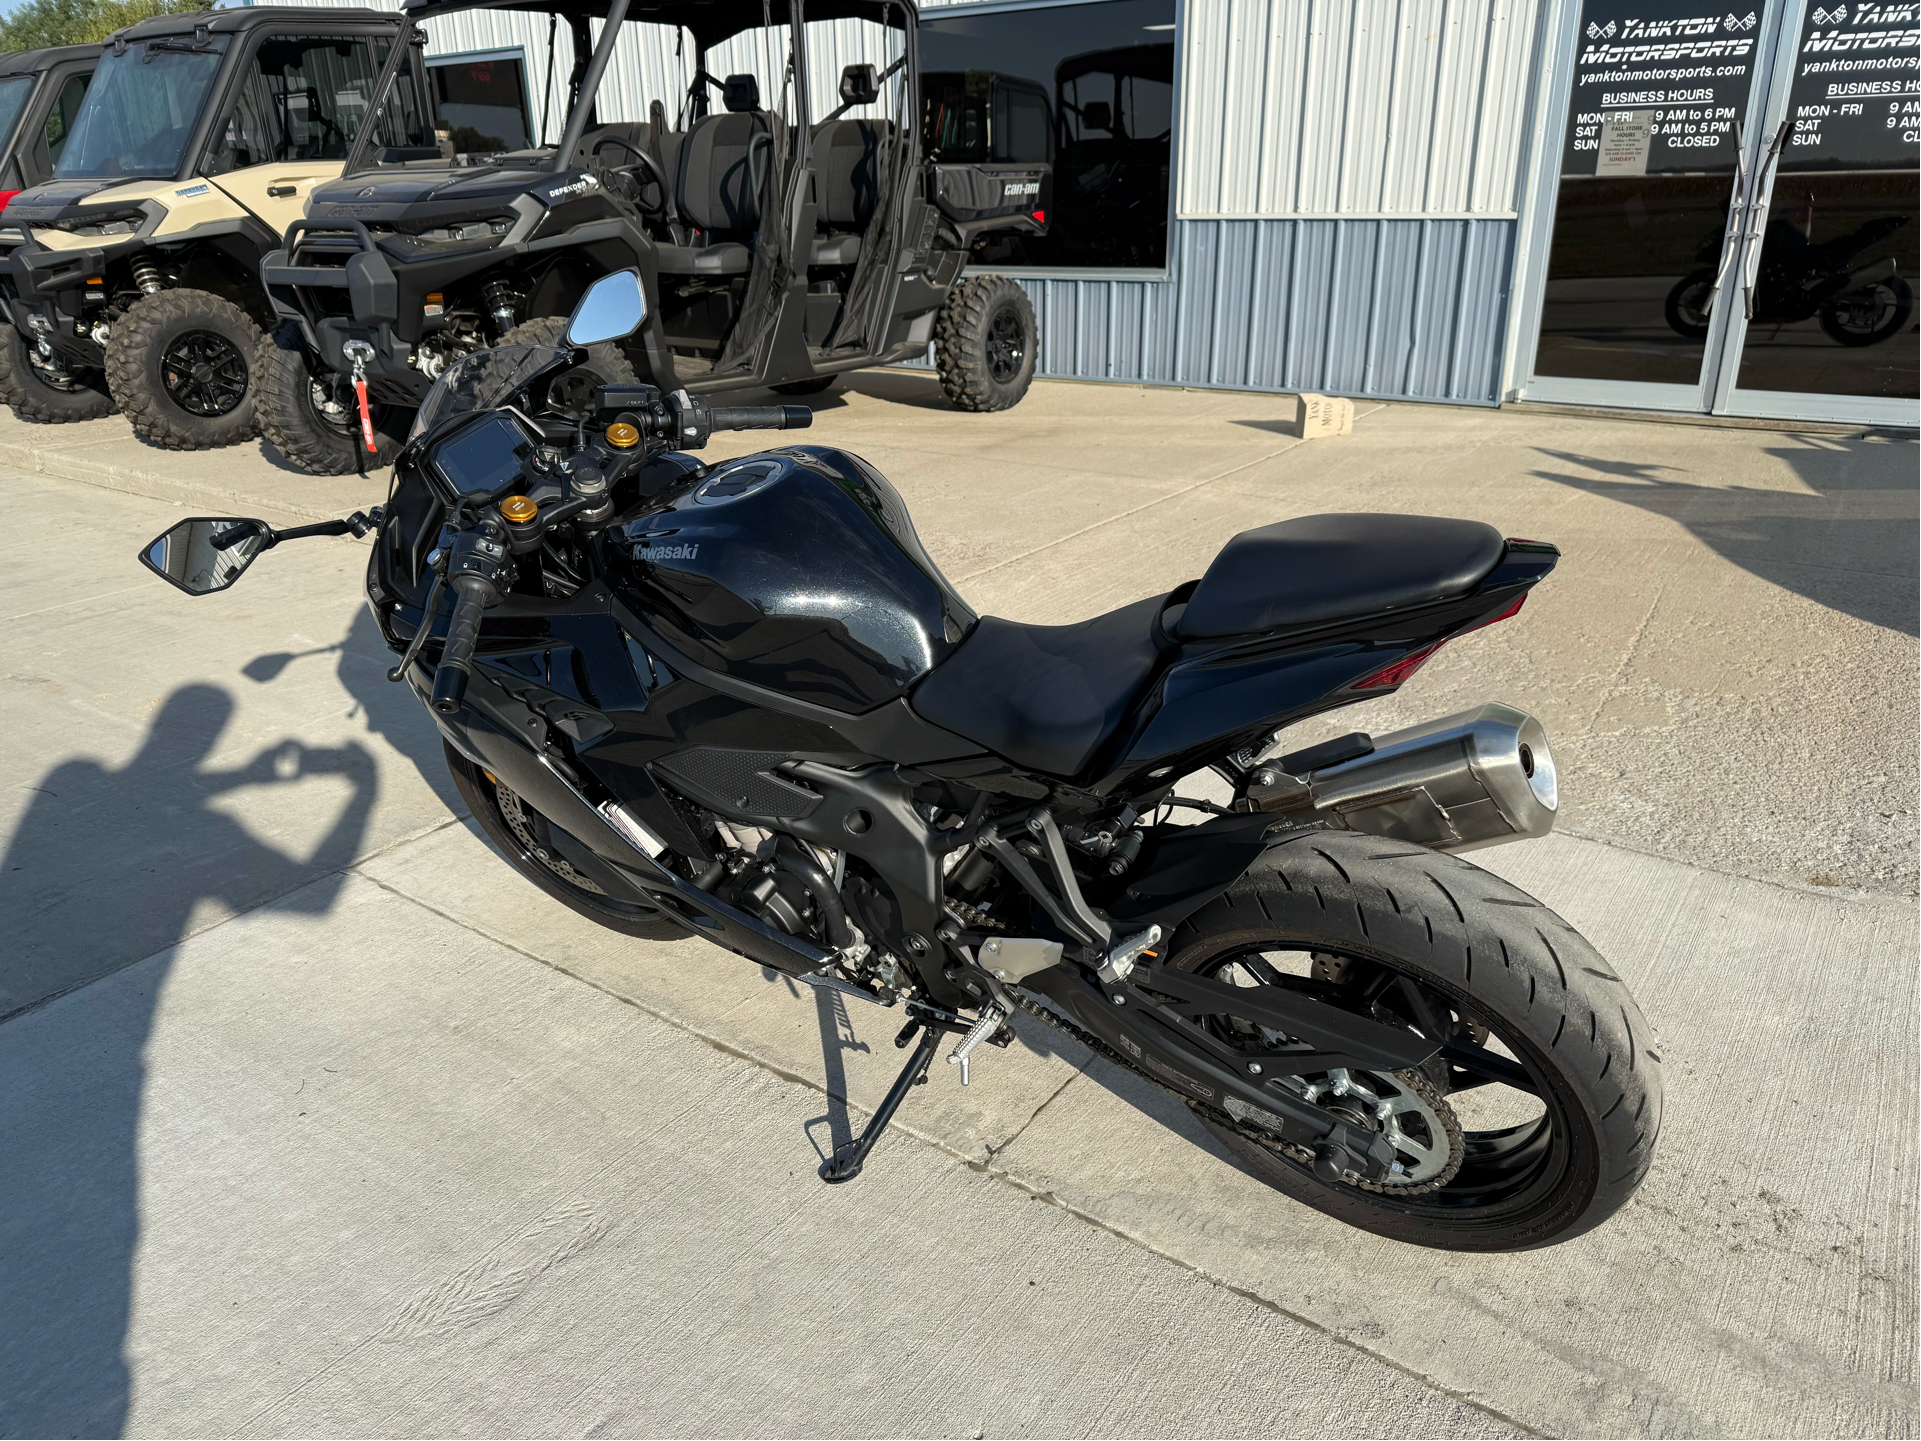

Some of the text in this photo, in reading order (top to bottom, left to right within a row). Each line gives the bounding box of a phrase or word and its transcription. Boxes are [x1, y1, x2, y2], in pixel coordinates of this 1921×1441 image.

[1851, 2, 1920, 25] YANK
[1621, 17, 1721, 39] YANKTON
[1579, 39, 1754, 65] MOTORSPORTS
[1579, 65, 1746, 86] yanktonmotorsports.com
[1602, 88, 1714, 104] BUSINESS HOURS
[1827, 81, 1901, 95] BUSINESS
[1577, 113, 1605, 124] MON
[1614, 111, 1633, 122] FRI
[1655, 110, 1664, 121] 9
[1666, 109, 1687, 121] AM
[1689, 109, 1701, 120] to
[1704, 109, 1713, 119] 6
[1715, 107, 1735, 119] PM
[1797, 105, 1830, 117] MON
[1840, 103, 1864, 116] FRI
[1889, 102, 1899, 114] 9
[1575, 121, 1730, 137] SAT 9 AM to 5 PM
[1795, 116, 1920, 131] SAT 9 AM
[1573, 135, 1720, 150] SUN CLOSED
[1792, 133, 1821, 146] SUN
[549, 180, 587, 197] DEFENDER
[1004, 182, 1039, 195] can-am
[632, 543, 699, 560] Kawasaki
